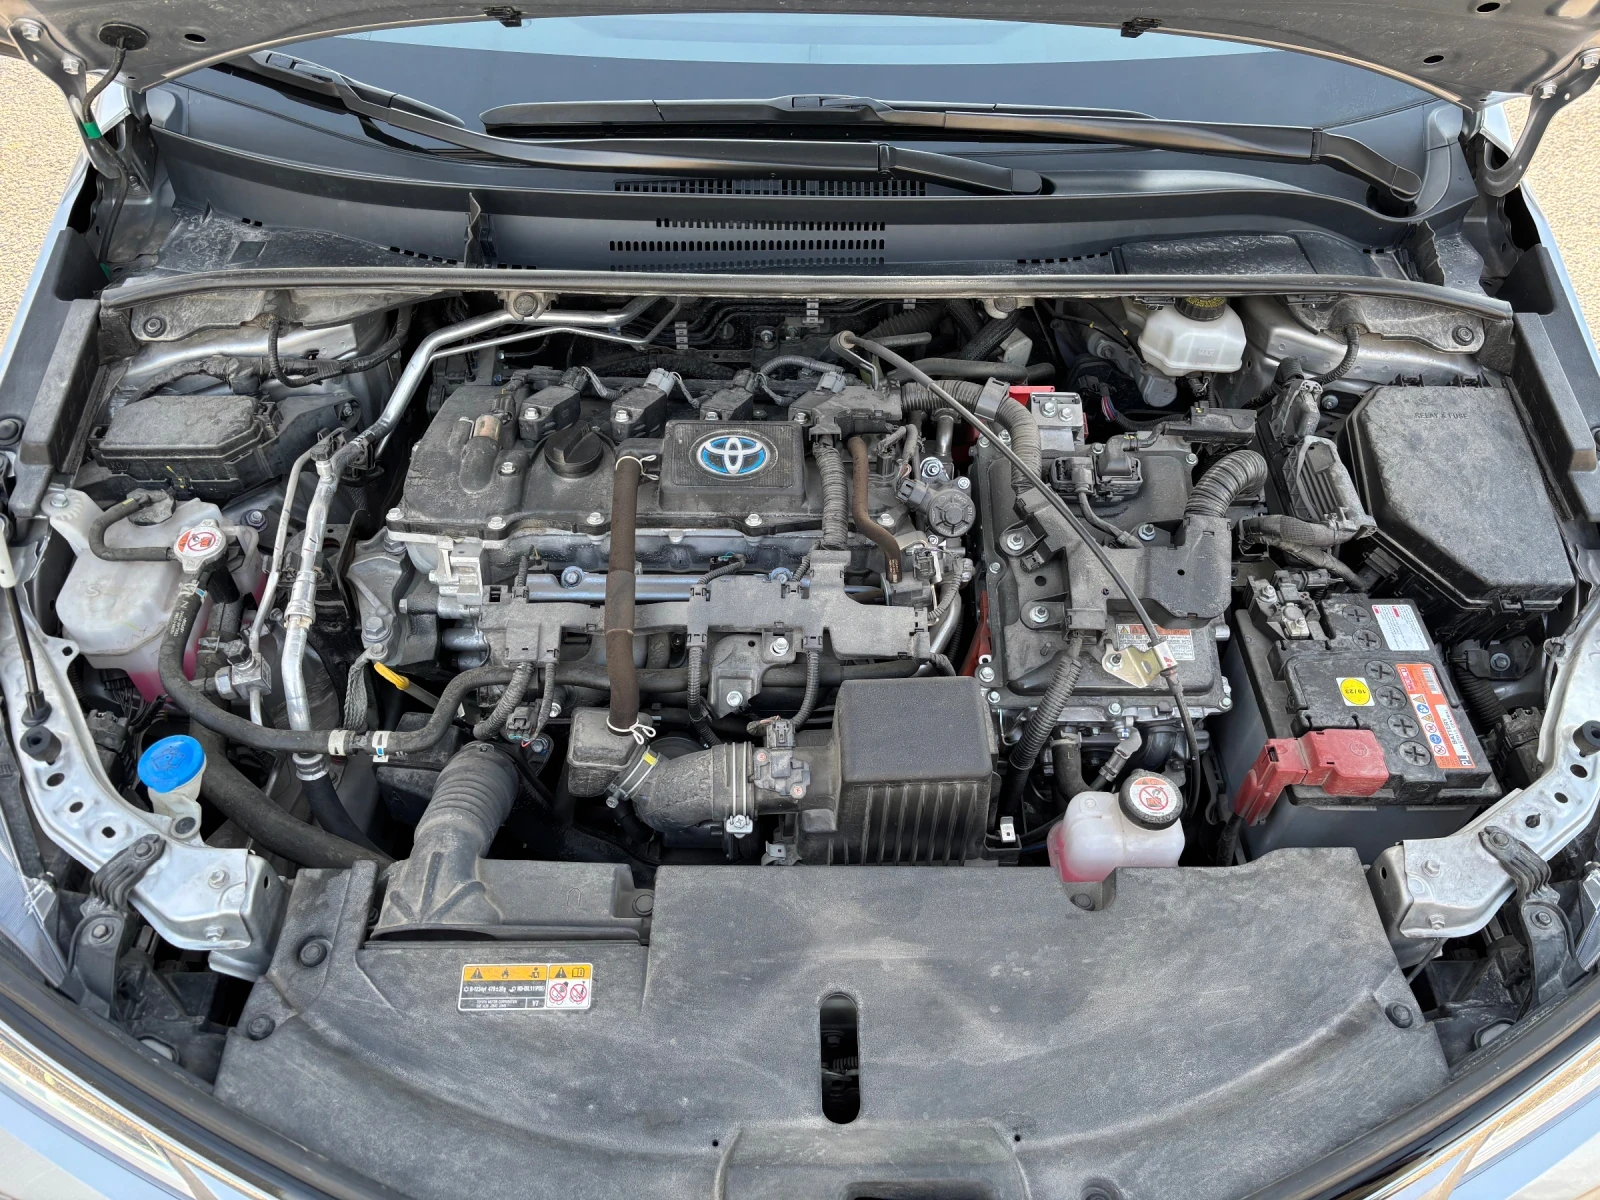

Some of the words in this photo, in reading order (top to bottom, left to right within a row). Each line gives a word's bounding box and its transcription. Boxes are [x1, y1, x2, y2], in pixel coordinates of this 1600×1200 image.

[1198, 348, 1215, 357] MAX
[1448, 412, 1469, 420] FUSE
[1443, 717, 1458, 745] BATTERY
[1460, 755, 1473, 766] PL
[1142, 813, 1171, 822] DENSO
